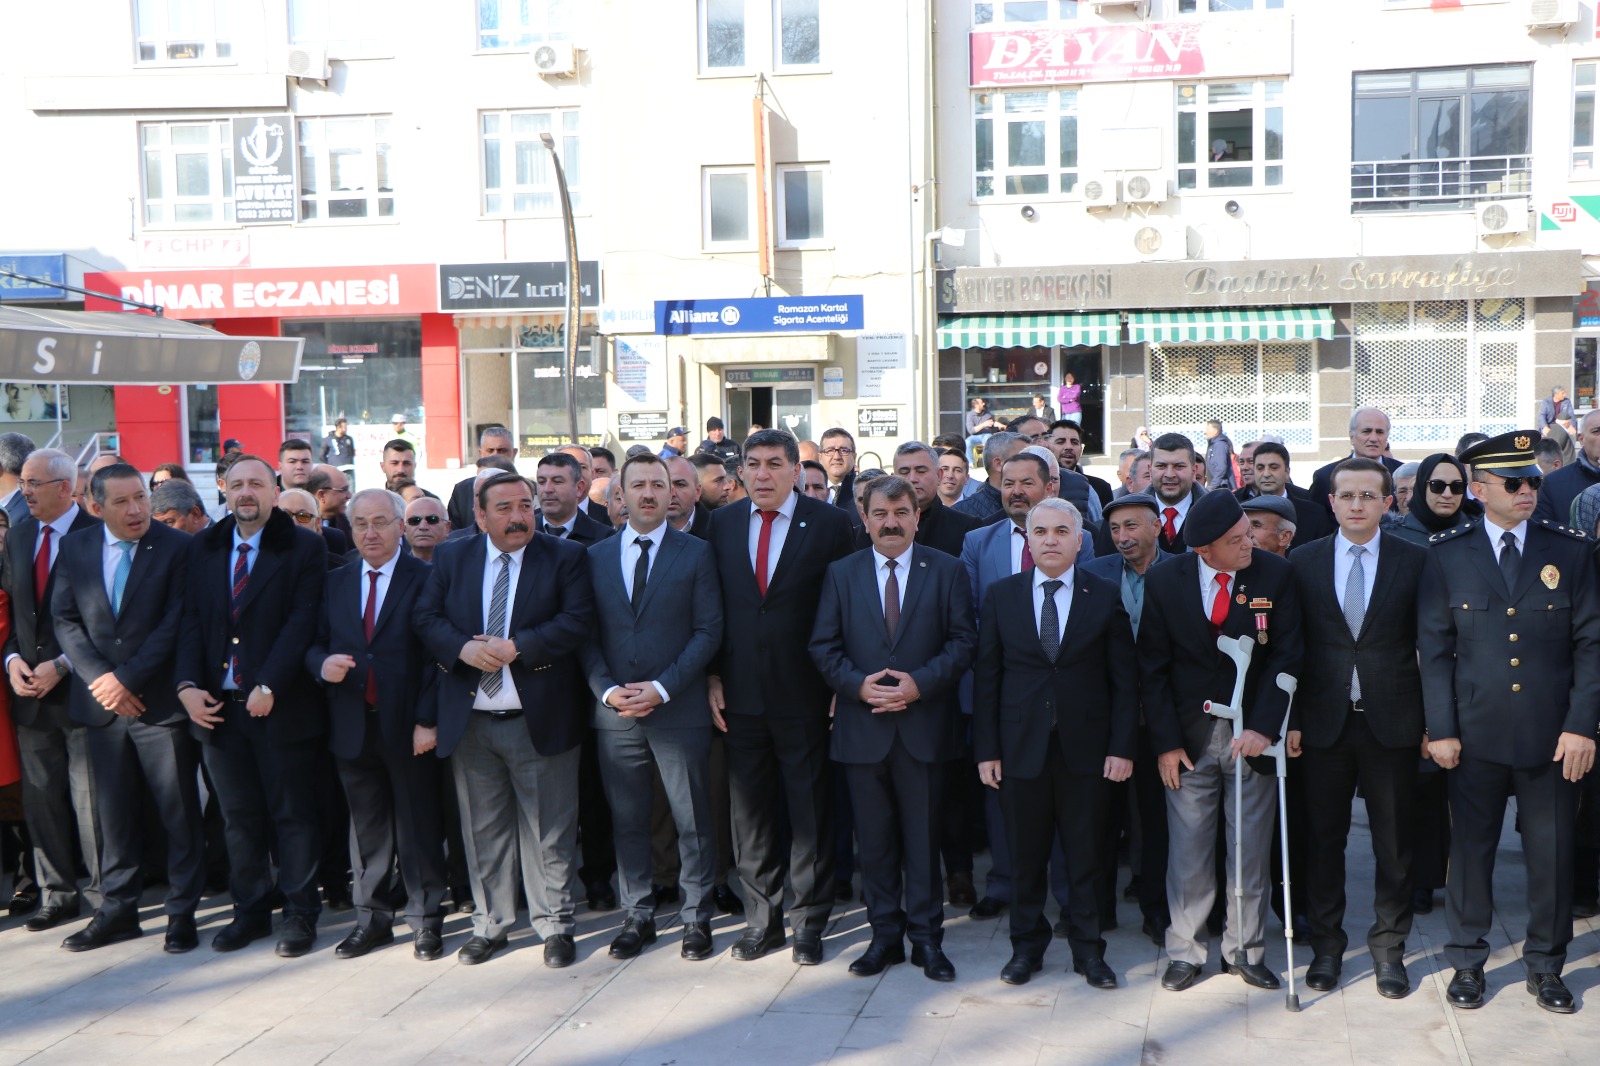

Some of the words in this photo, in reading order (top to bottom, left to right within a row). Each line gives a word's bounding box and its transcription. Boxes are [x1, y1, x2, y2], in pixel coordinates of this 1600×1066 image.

[983, 28, 1189, 69] DAYAN
[235, 184, 293, 200] AVUKAT
[170, 239, 214, 252] CHP
[1339, 258, 1517, 294] Sarrafiye
[121, 279, 224, 311] DİNAR
[233, 274, 400, 308] ECZANESİ
[448, 275, 520, 300] DENİZ
[1020, 268, 1112, 306] BÖREKÇİSİ
[669, 309, 719, 324] Allianz
[778, 304, 819, 314] Ramazan
[820, 303, 848, 313] Kartal
[773, 315, 805, 326] Sigorta
[806, 314, 849, 325] Acenteliği
[727, 371, 750, 381] OTEL
